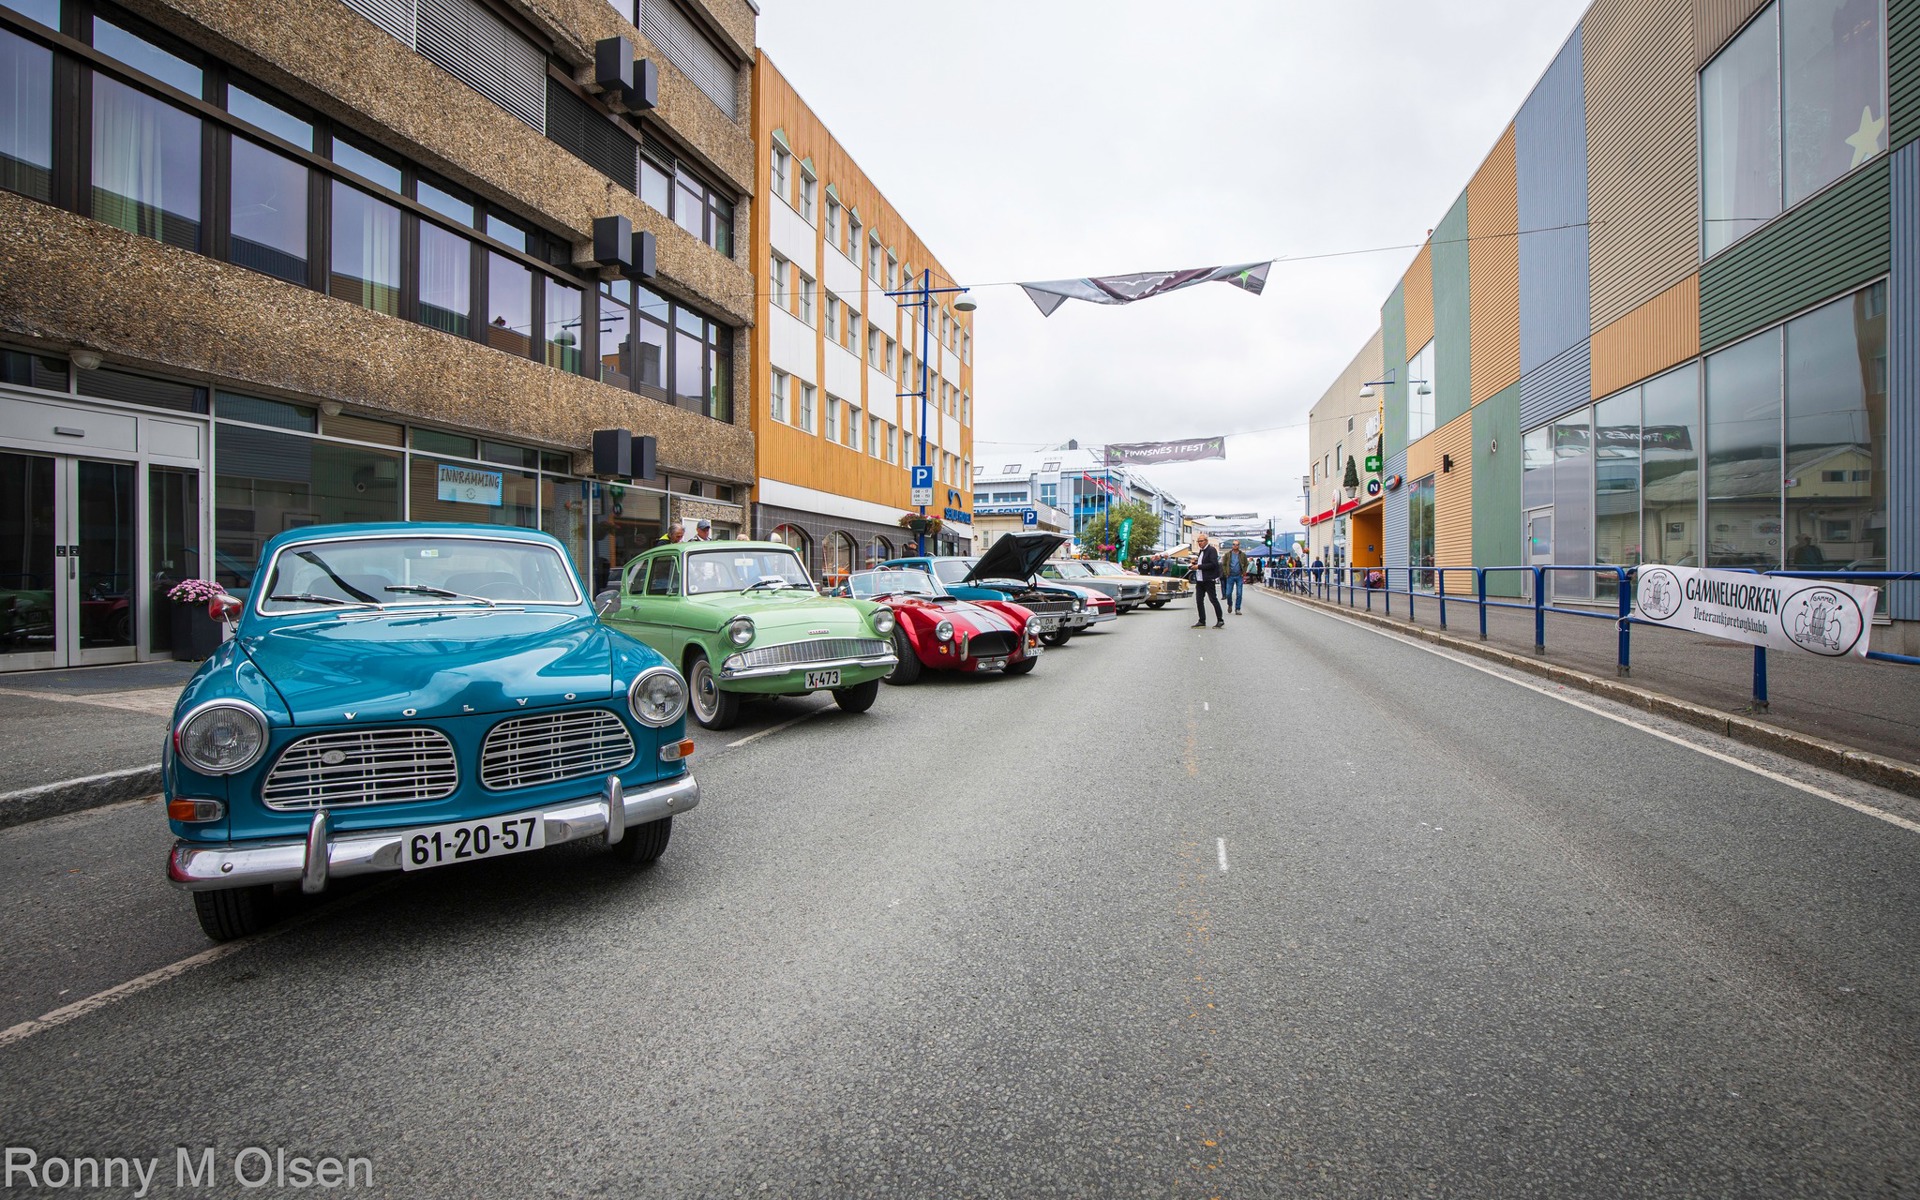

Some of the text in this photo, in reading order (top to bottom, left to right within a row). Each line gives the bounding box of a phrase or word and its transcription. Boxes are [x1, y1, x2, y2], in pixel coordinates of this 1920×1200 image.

[1174, 445, 1179, 453] I
[1180, 442, 1206, 453] FEST
[440, 468, 500, 489] INNRAMMING
[916, 468, 928, 486] P
[1370, 483, 1379, 492] N
[1026, 512, 1035, 524] P
[1686, 577, 1781, 615] GAMMELHORKEN
[410, 817, 537, 865] 61-20-57
